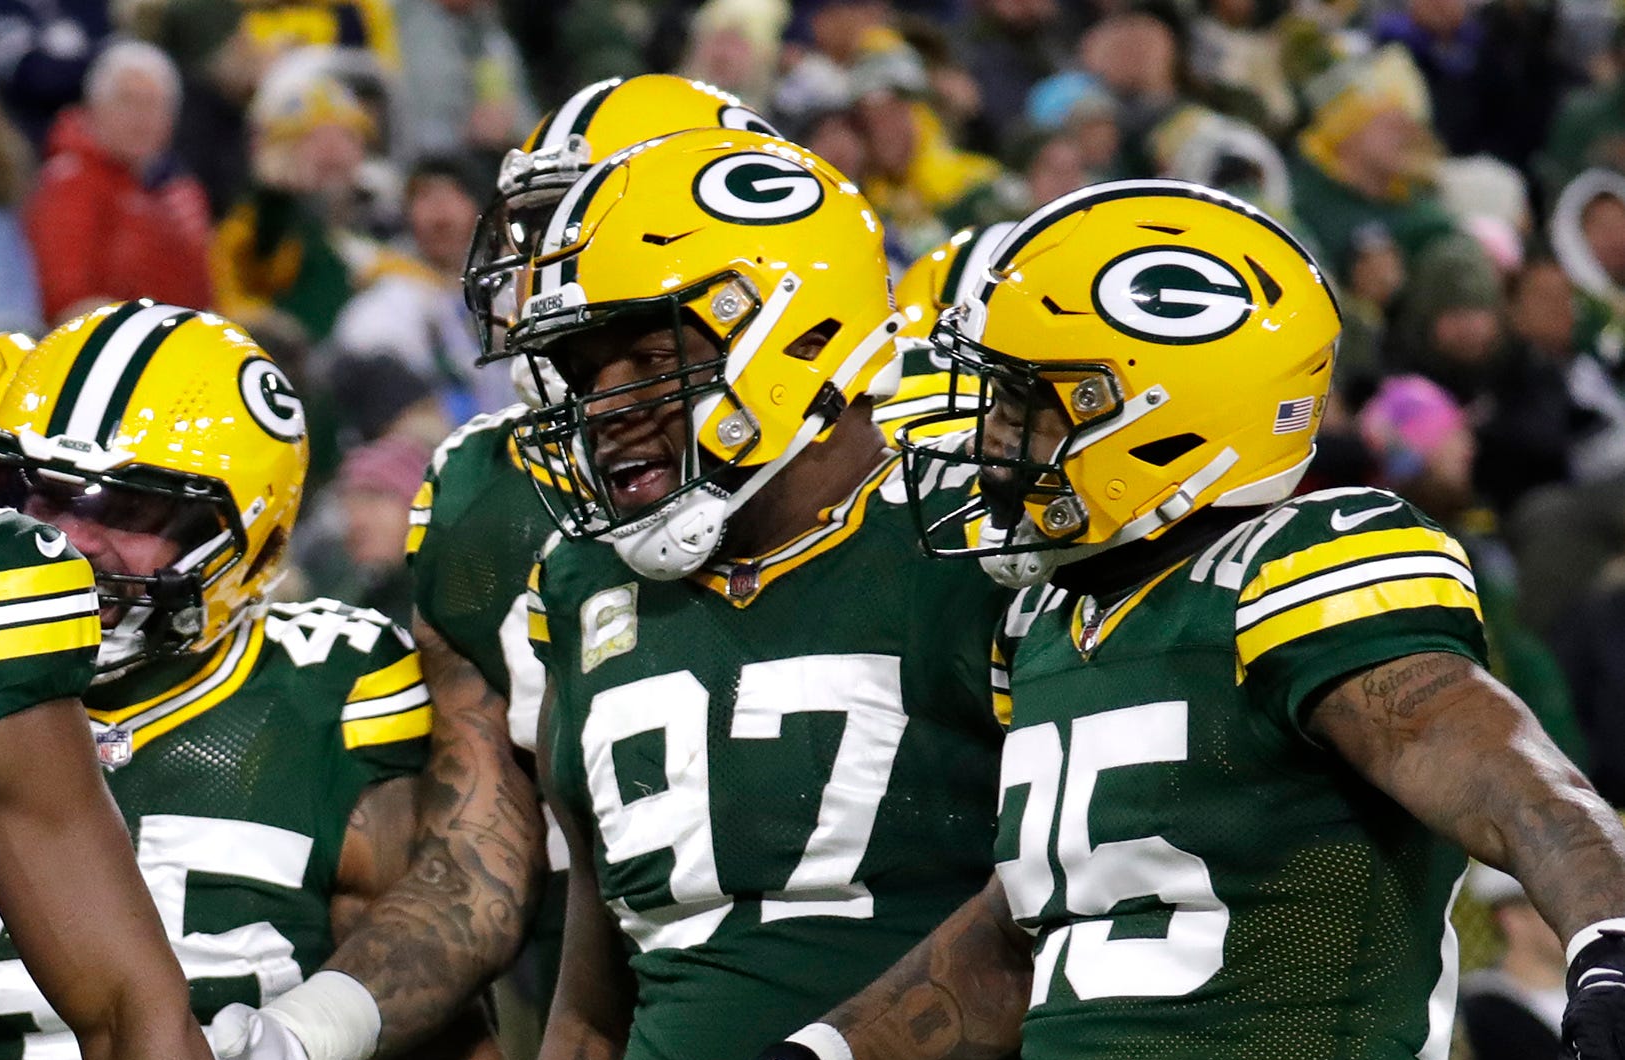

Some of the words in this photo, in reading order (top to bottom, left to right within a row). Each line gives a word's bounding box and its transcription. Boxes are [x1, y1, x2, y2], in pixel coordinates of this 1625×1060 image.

[697, 155, 821, 220] G
[1097, 249, 1248, 341] G
[242, 358, 306, 441] G
[586, 589, 633, 650] C
[581, 653, 910, 953] 97
[994, 700, 1230, 1011] 25
